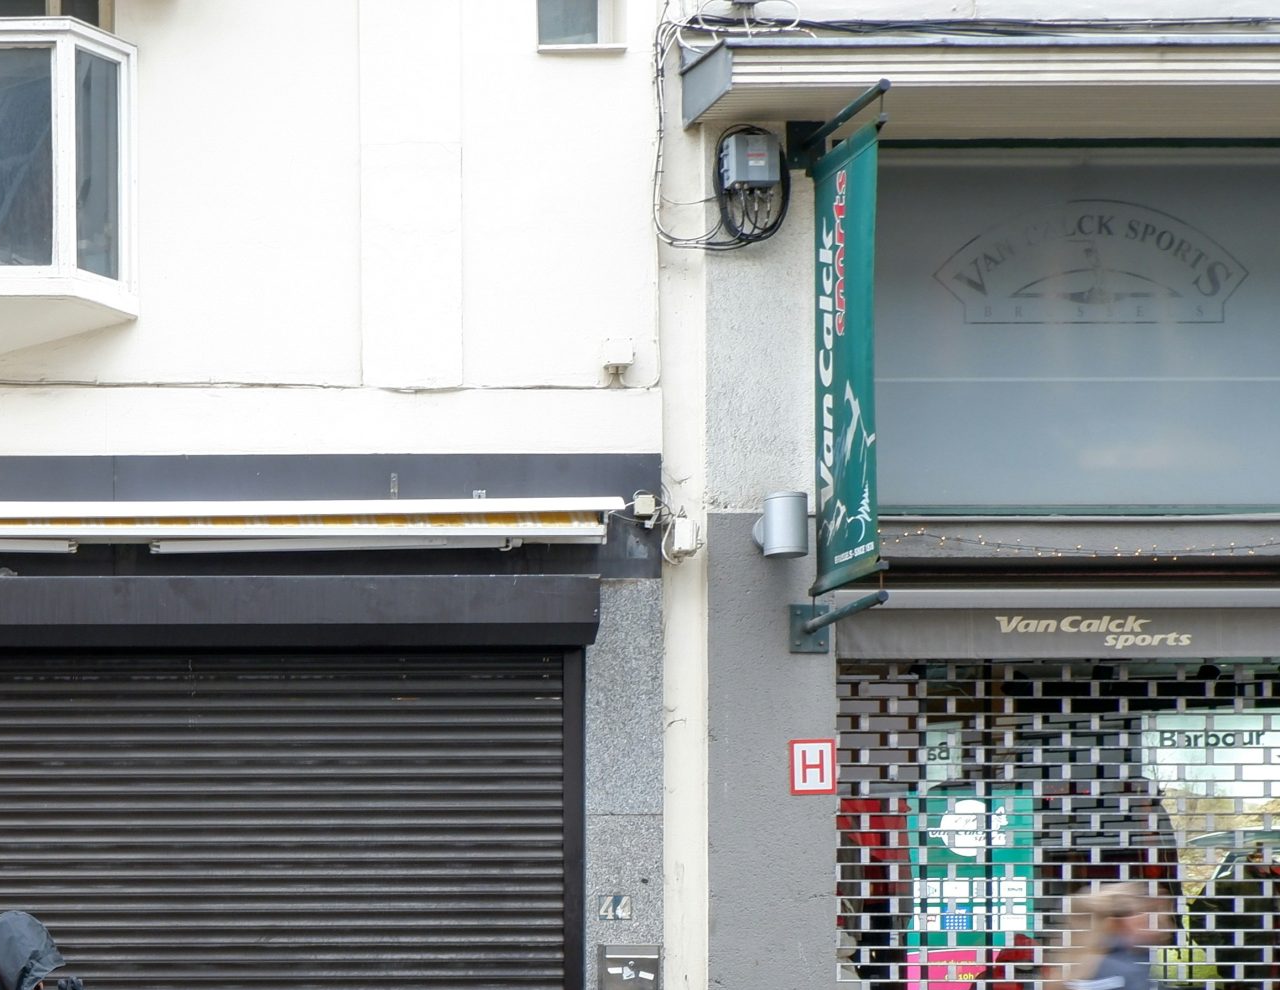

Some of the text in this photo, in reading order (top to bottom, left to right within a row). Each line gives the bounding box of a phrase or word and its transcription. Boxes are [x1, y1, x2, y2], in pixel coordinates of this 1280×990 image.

[1125, 218, 1233, 298] SPORTS
[1104, 632, 1193, 650] sports
[801, 749, 825, 784] H
